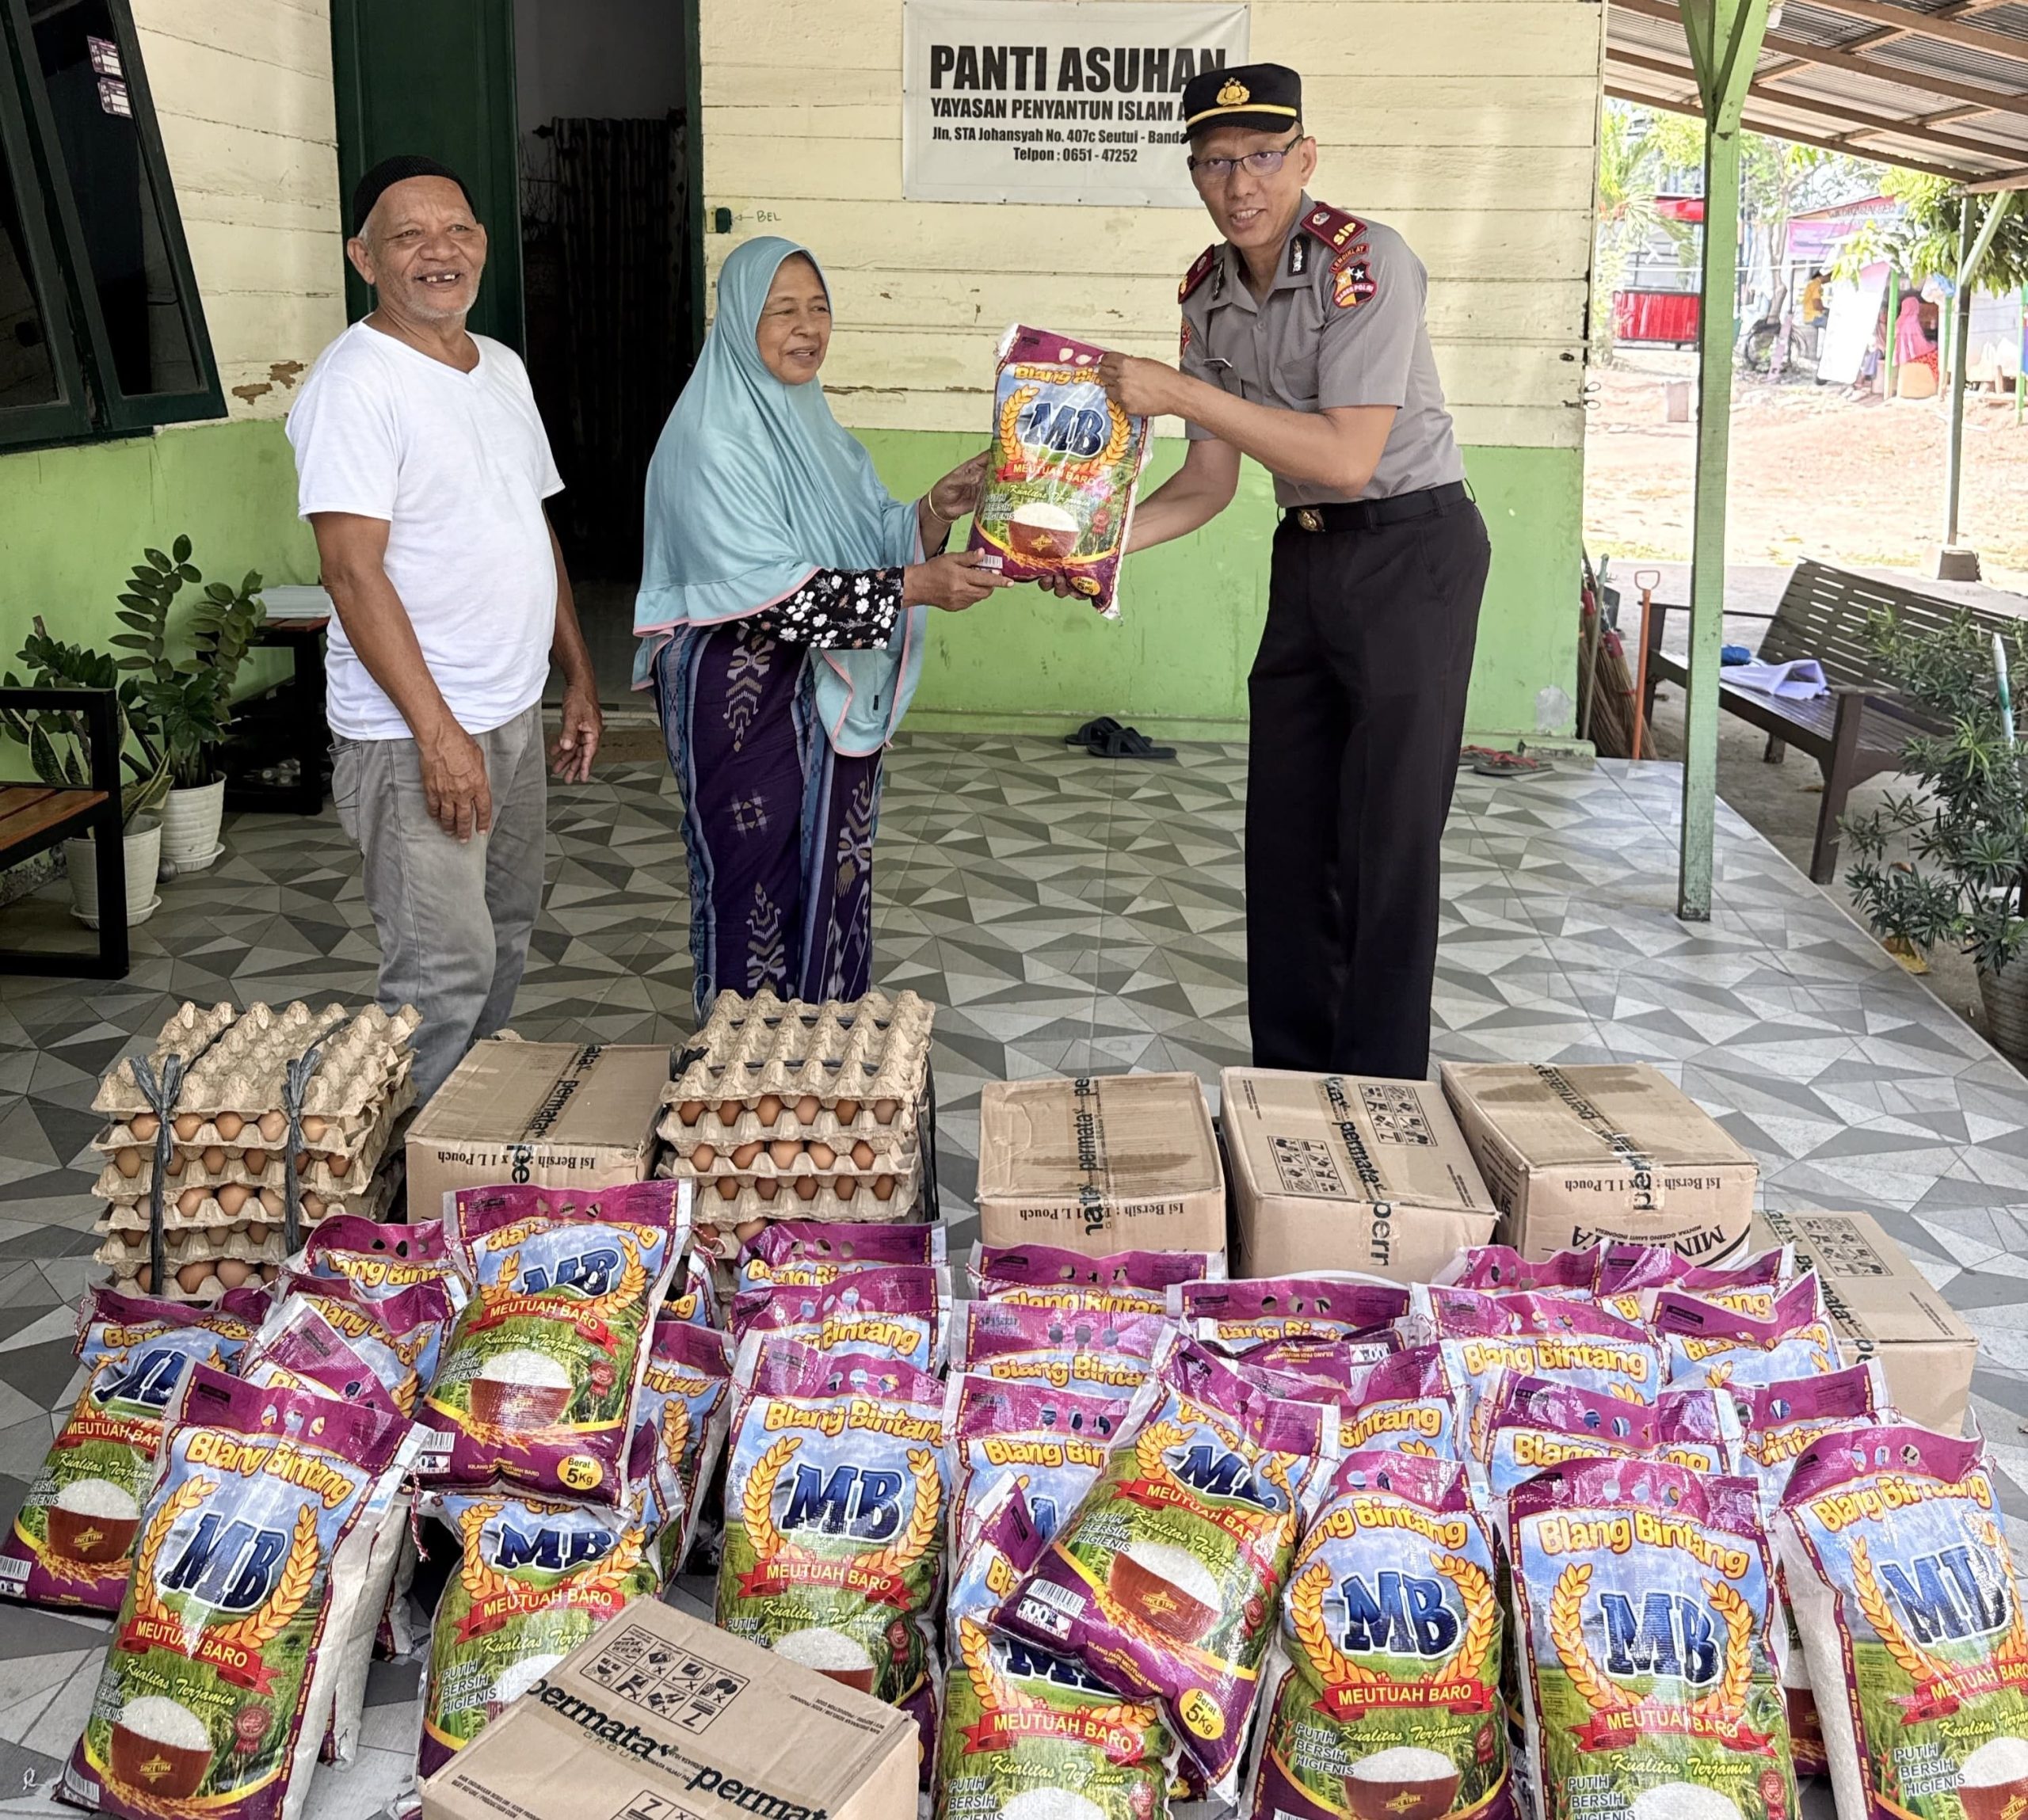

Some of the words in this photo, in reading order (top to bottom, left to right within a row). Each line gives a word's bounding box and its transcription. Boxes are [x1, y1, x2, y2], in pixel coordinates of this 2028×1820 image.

[930, 45, 1047, 91] PANTI
[931, 97, 1007, 119] YAYASAN
[1012, 98, 1113, 120] PENYANTUN
[1118, 101, 1173, 121] ISLAM
[955, 128, 977, 141] STA
[979, 128, 1043, 143] Johansyah
[1046, 129, 1065, 143] No.
[1067, 130, 1096, 143] 407c
[1013, 147, 1055, 162] Telpon
[1063, 148, 1092, 162] 0651
[1101, 149, 1138, 162] 47252
[757, 210, 781, 223] BEL
[1024, 402, 1104, 457] MB
[437, 1152, 475, 1165] Pouch
[478, 1153, 488, 1165] L
[539, 1156, 576, 1169] Bersih
[581, 1156, 595, 1169] Isi
[1565, 1181, 1602, 1192] Pouch
[1605, 1180, 1614, 1191] L
[1664, 1178, 1702, 1190] Bersih
[1706, 1178, 1721, 1189] Isi
[1020, 1208, 1058, 1220] Pouch
[1062, 1209, 1071, 1219] L
[1124, 1204, 1165, 1217] Bersih
[1169, 1203, 1184, 1214] Isi
[490, 1303, 557, 1319] MEUTUAH
[559, 1304, 599, 1331] BARO
[482, 1331, 531, 1346] Kualitas
[537, 1332, 591, 1358] Terjamin
[822, 1316, 921, 1355] Bintang
[1463, 1342, 1534, 1376] Blang
[1537, 1338, 1648, 1383] Bintang
[67, 1422, 129, 1439] MEUTUAH
[764, 1401, 845, 1437] Blang
[848, 1399, 943, 1448] Bintang
[59, 1453, 103, 1472] Kualitas
[568, 1456, 591, 1468] Berat
[983, 1440, 1062, 1467] Blang
[185, 1432, 270, 1478] Blang
[262, 1439, 356, 1510] Bintang
[782, 1464, 903, 1541] MB
[1146, 1483, 1221, 1522] MEUTUAH
[1810, 1490, 1884, 1533] Blang
[1088, 1512, 1126, 1525] PUTIH
[1133, 1508, 1187, 1541] Kualitas
[1354, 1497, 1468, 1550] Bintang
[1081, 1523, 1131, 1540] BERSIH
[492, 1522, 616, 1571] MB
[1076, 1533, 1132, 1553] HIGIENIS
[1538, 1516, 1631, 1555] Blang
[1633, 1511, 1750, 1579] Bintang
[160, 1512, 287, 1611] MB
[766, 1563, 844, 1582] MEUTUAH
[848, 1569, 891, 1592] BARO
[482, 1592, 562, 1617] MEUTUAH
[567, 1587, 612, 1606] BARO
[1142, 1593, 1161, 1606] SINCE
[763, 1600, 819, 1620] Kualitas
[827, 1608, 887, 1627] Terjamin
[1020, 1598, 1056, 1624] 100%
[1342, 1571, 1459, 1656] MB
[726, 1618, 758, 1630] PUTIH
[135, 1620, 204, 1656] MEUTUAH
[202, 1640, 248, 1668] BARO
[482, 1634, 542, 1654] Kualitas
[1598, 1591, 1721, 1686] MB
[442, 1660, 478, 1681] PUTIH
[125, 1658, 170, 1689] Kualitas
[175, 1678, 237, 1707] Terjamin
[442, 1674, 488, 1698] BERSIH
[443, 1689, 497, 1715] HIGIENIS
[1195, 1691, 1218, 1716] Berat
[1338, 1688, 1424, 1705] MEUTUAH
[1429, 1684, 1472, 1702] BARO
[993, 1713, 1080, 1736] MEUTUAH
[1085, 1723, 1132, 1753] BARO
[1295, 1723, 1336, 1744] PUTIH
[1340, 1727, 1403, 1742] Kualitas
[1411, 1723, 1472, 1743] Terjamin
[1694, 1715, 1739, 1738] BARO
[1938, 1721, 1996, 1738] Kualitas
[1295, 1740, 1347, 1761] BERSIH
[1895, 1744, 1938, 1760] PUTIH
[991, 1754, 1055, 1778] Kualitas
[1063, 1763, 1124, 1788] Terjamin
[1295, 1755, 1355, 1776] HIGIENIS
[1611, 1753, 1680, 1774] Kualitas
[1687, 1758, 1752, 1780] Terjamin
[1901, 1759, 1953, 1778] BERSIH
[950, 1776, 985, 1792] PUTIH
[1569, 1776, 1609, 1789] PUTIH
[1906, 1774, 1965, 1795] HIGIENIS
[950, 1795, 995, 1810] BERSIH
[1572, 1794, 1623, 1809] BERSIH
